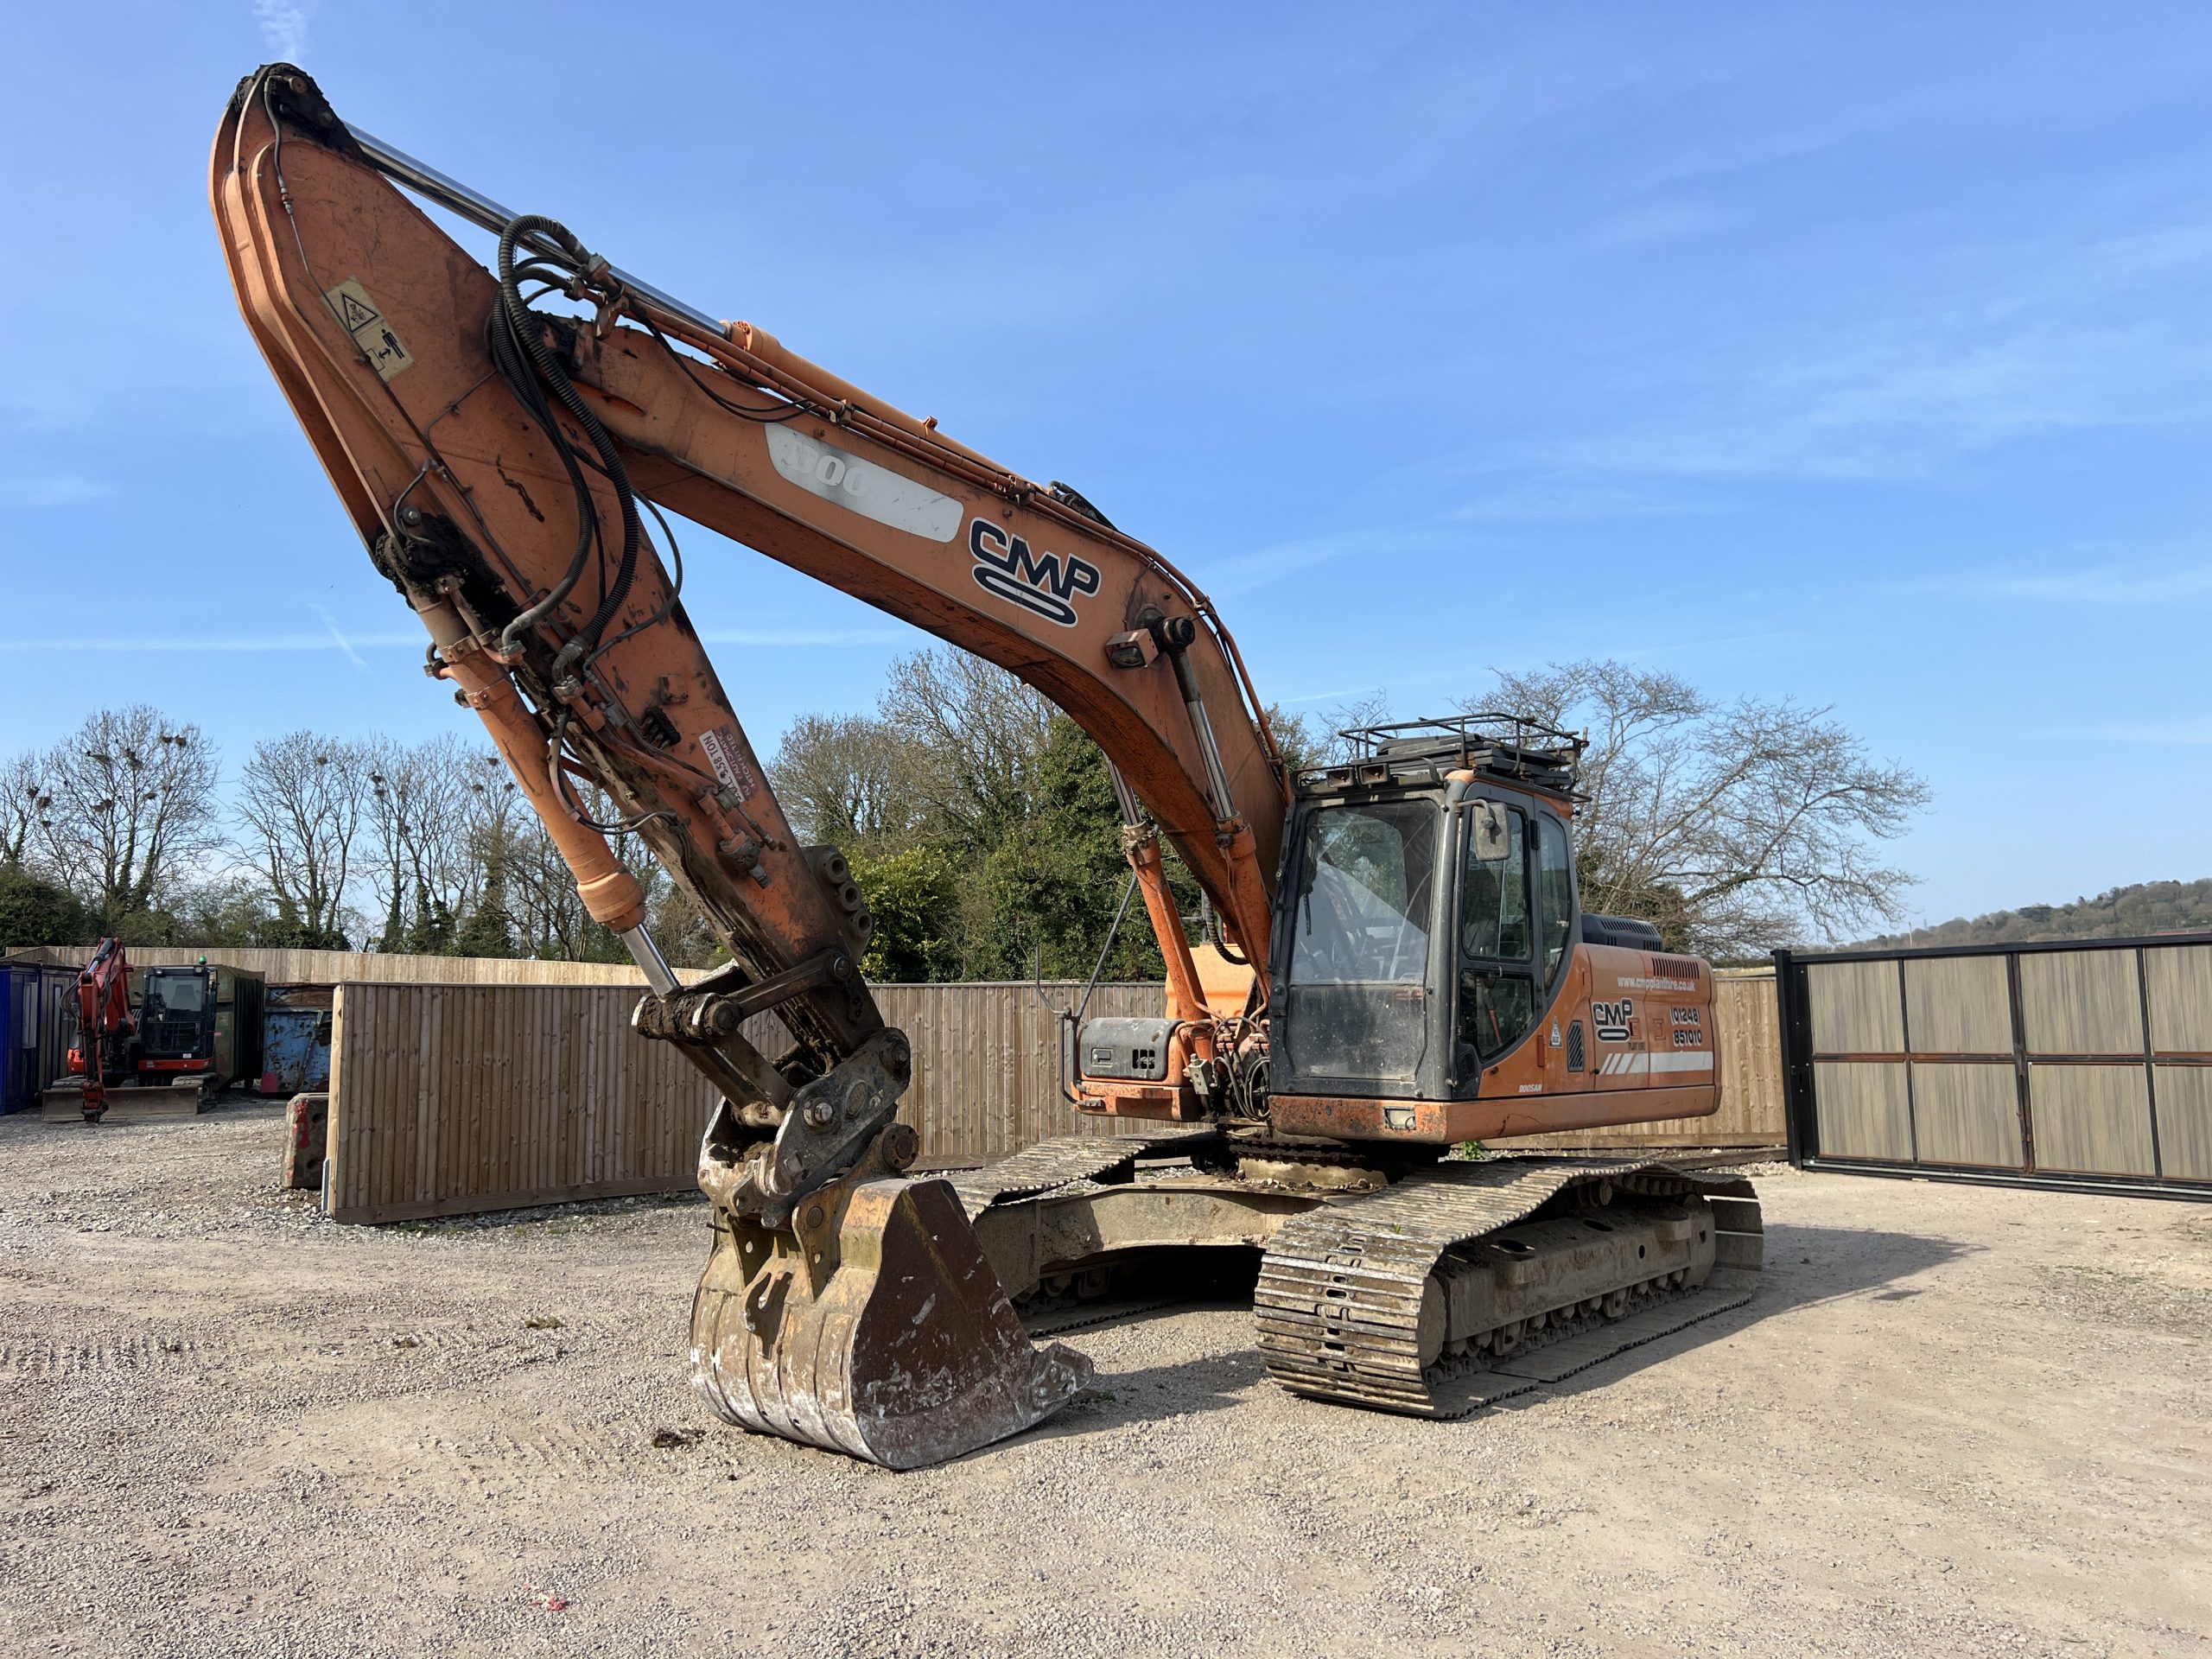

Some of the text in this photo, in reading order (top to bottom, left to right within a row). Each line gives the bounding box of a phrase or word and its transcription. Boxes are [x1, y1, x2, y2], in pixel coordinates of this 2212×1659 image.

[969, 517, 1102, 605] CMP
[702, 735, 718, 757] TON
[740, 762, 755, 787] HITCH
[1618, 976, 1695, 991] www.cmpplanthire.co.uk
[1592, 998, 1633, 1027] CMP
[1670, 1007, 1700, 1026] (01248)
[1673, 1029, 1702, 1046] 851010
[1519, 1084, 1542, 1092] DOOSAN
